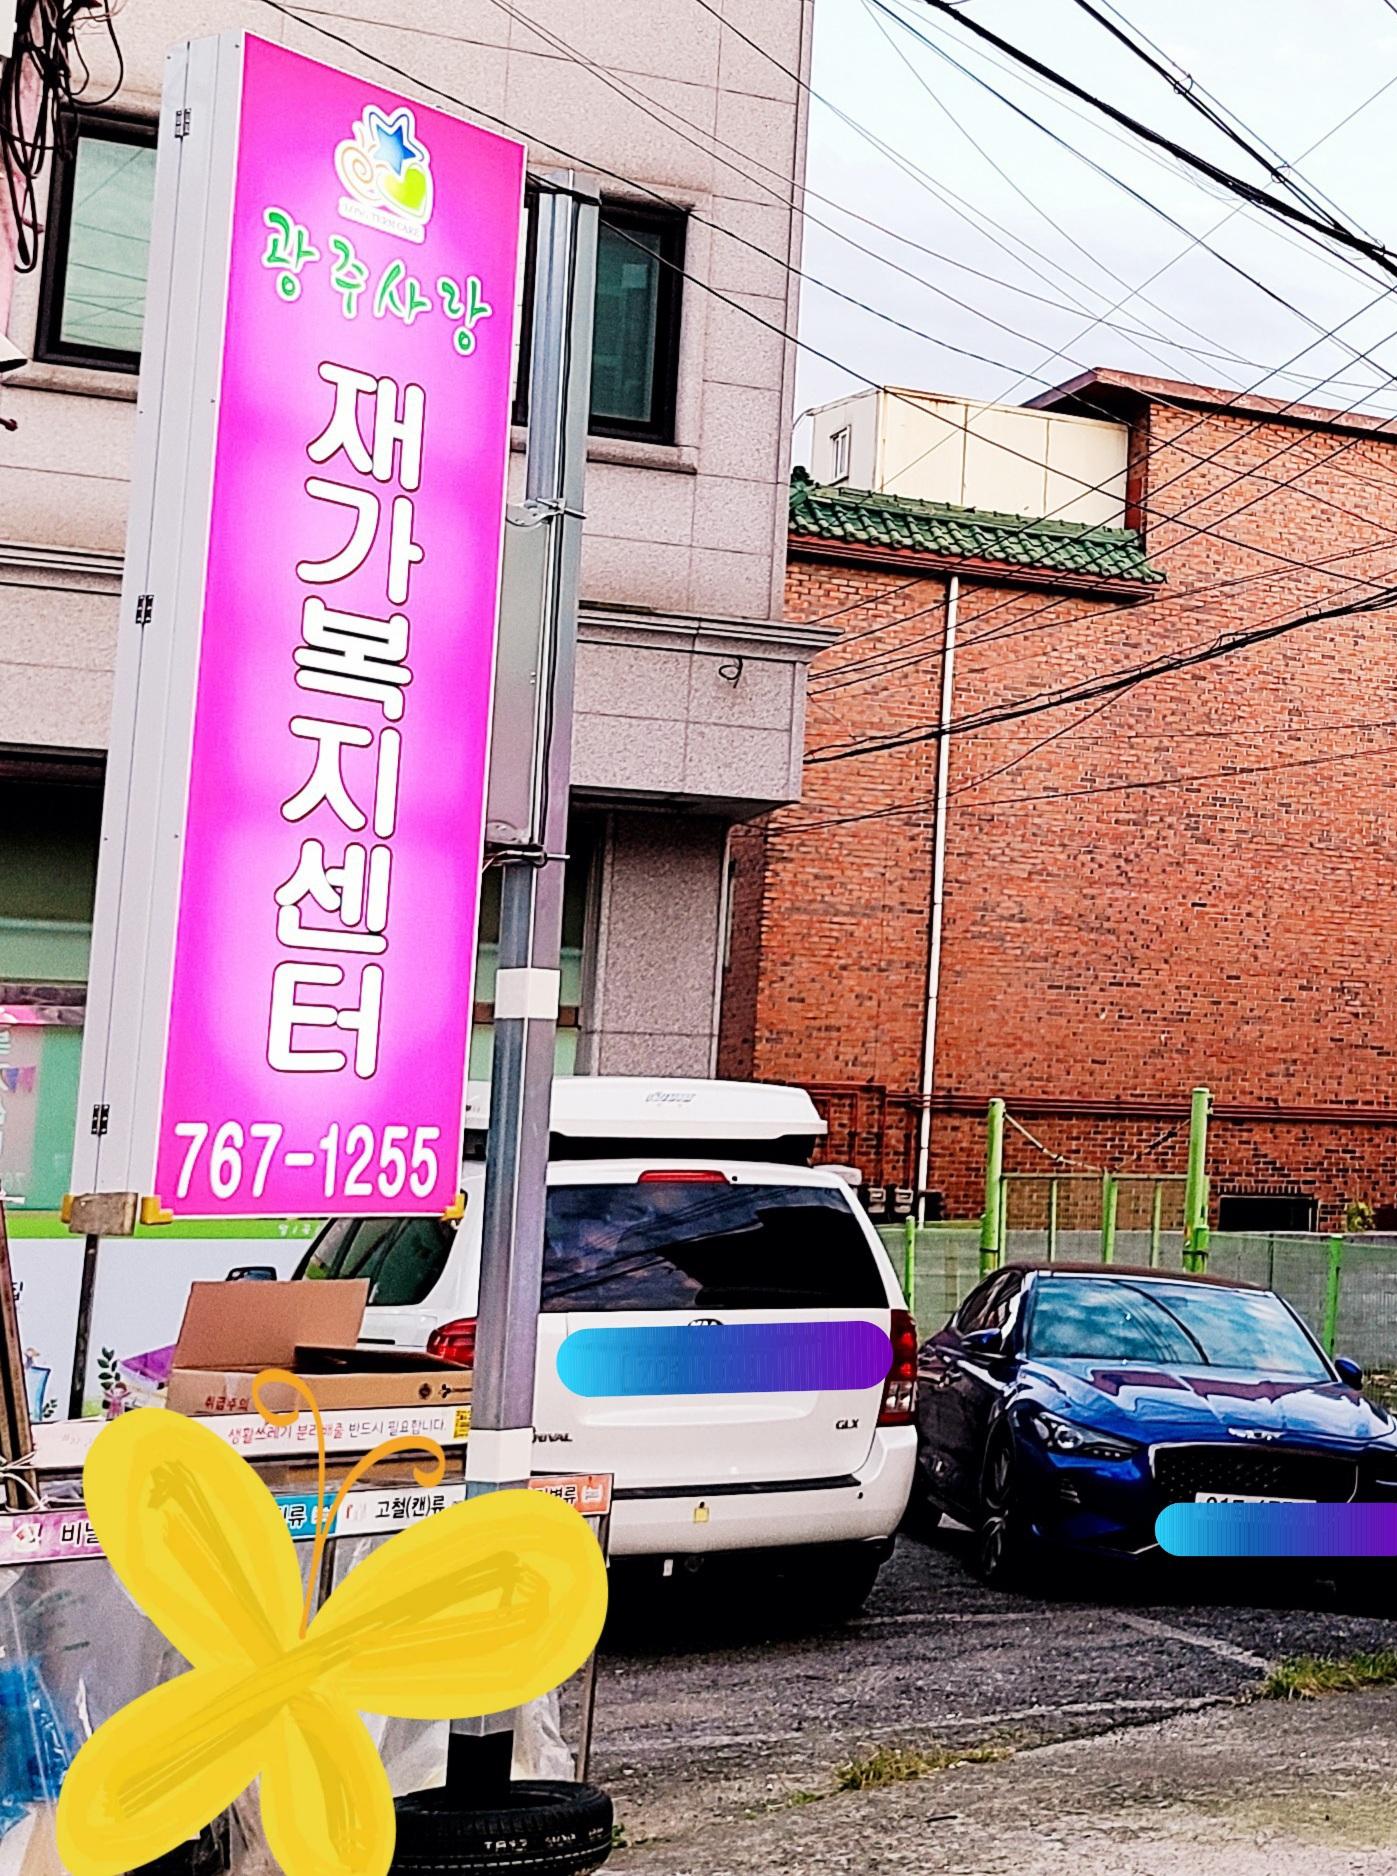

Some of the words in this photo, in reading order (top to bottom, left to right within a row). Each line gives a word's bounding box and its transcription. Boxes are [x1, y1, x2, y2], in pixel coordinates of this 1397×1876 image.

[263, 208, 491, 355] 광주사랑
[266, 361, 424, 1079] 재가복지센터
[174, 1122, 441, 1200] 767-1255
[349, 1421, 384, 1438] 반드시
[835, 1418, 860, 1430] GLX
[375, 1494, 446, 1519] 고철(캔)류
